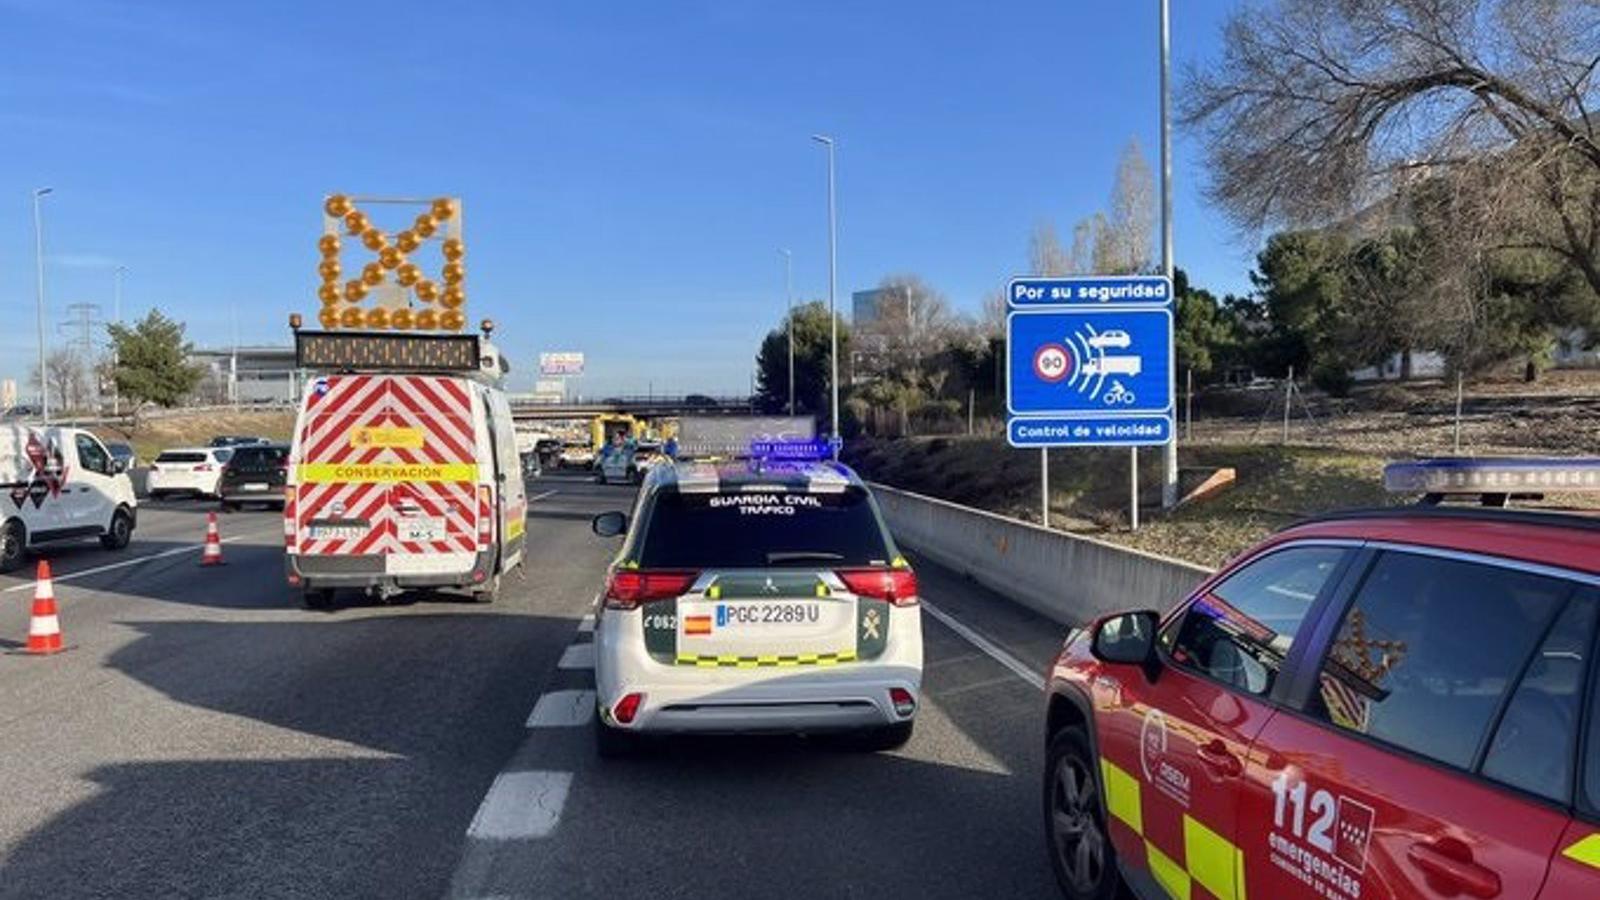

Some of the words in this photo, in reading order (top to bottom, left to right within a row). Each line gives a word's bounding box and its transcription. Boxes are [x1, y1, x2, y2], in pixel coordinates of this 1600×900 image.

[1014, 284, 1044, 299] Por
[1051, 286, 1072, 298] su
[1078, 283, 1166, 302] seguridad
[1041, 355, 1062, 370] 90
[1017, 424, 1069, 437] Control
[1072, 424, 1091, 437] de
[1095, 423, 1162, 437] velocidad
[334, 466, 442, 478] CONSERVACIÓN
[709, 495, 780, 508] GUARDIA
[784, 494, 822, 508] CIVIL
[727, 605, 759, 623] PGC
[761, 605, 805, 623] 2289
[807, 605, 820, 622] U
[1271, 772, 1336, 854] 112
[1268, 831, 1361, 899] emergencias
